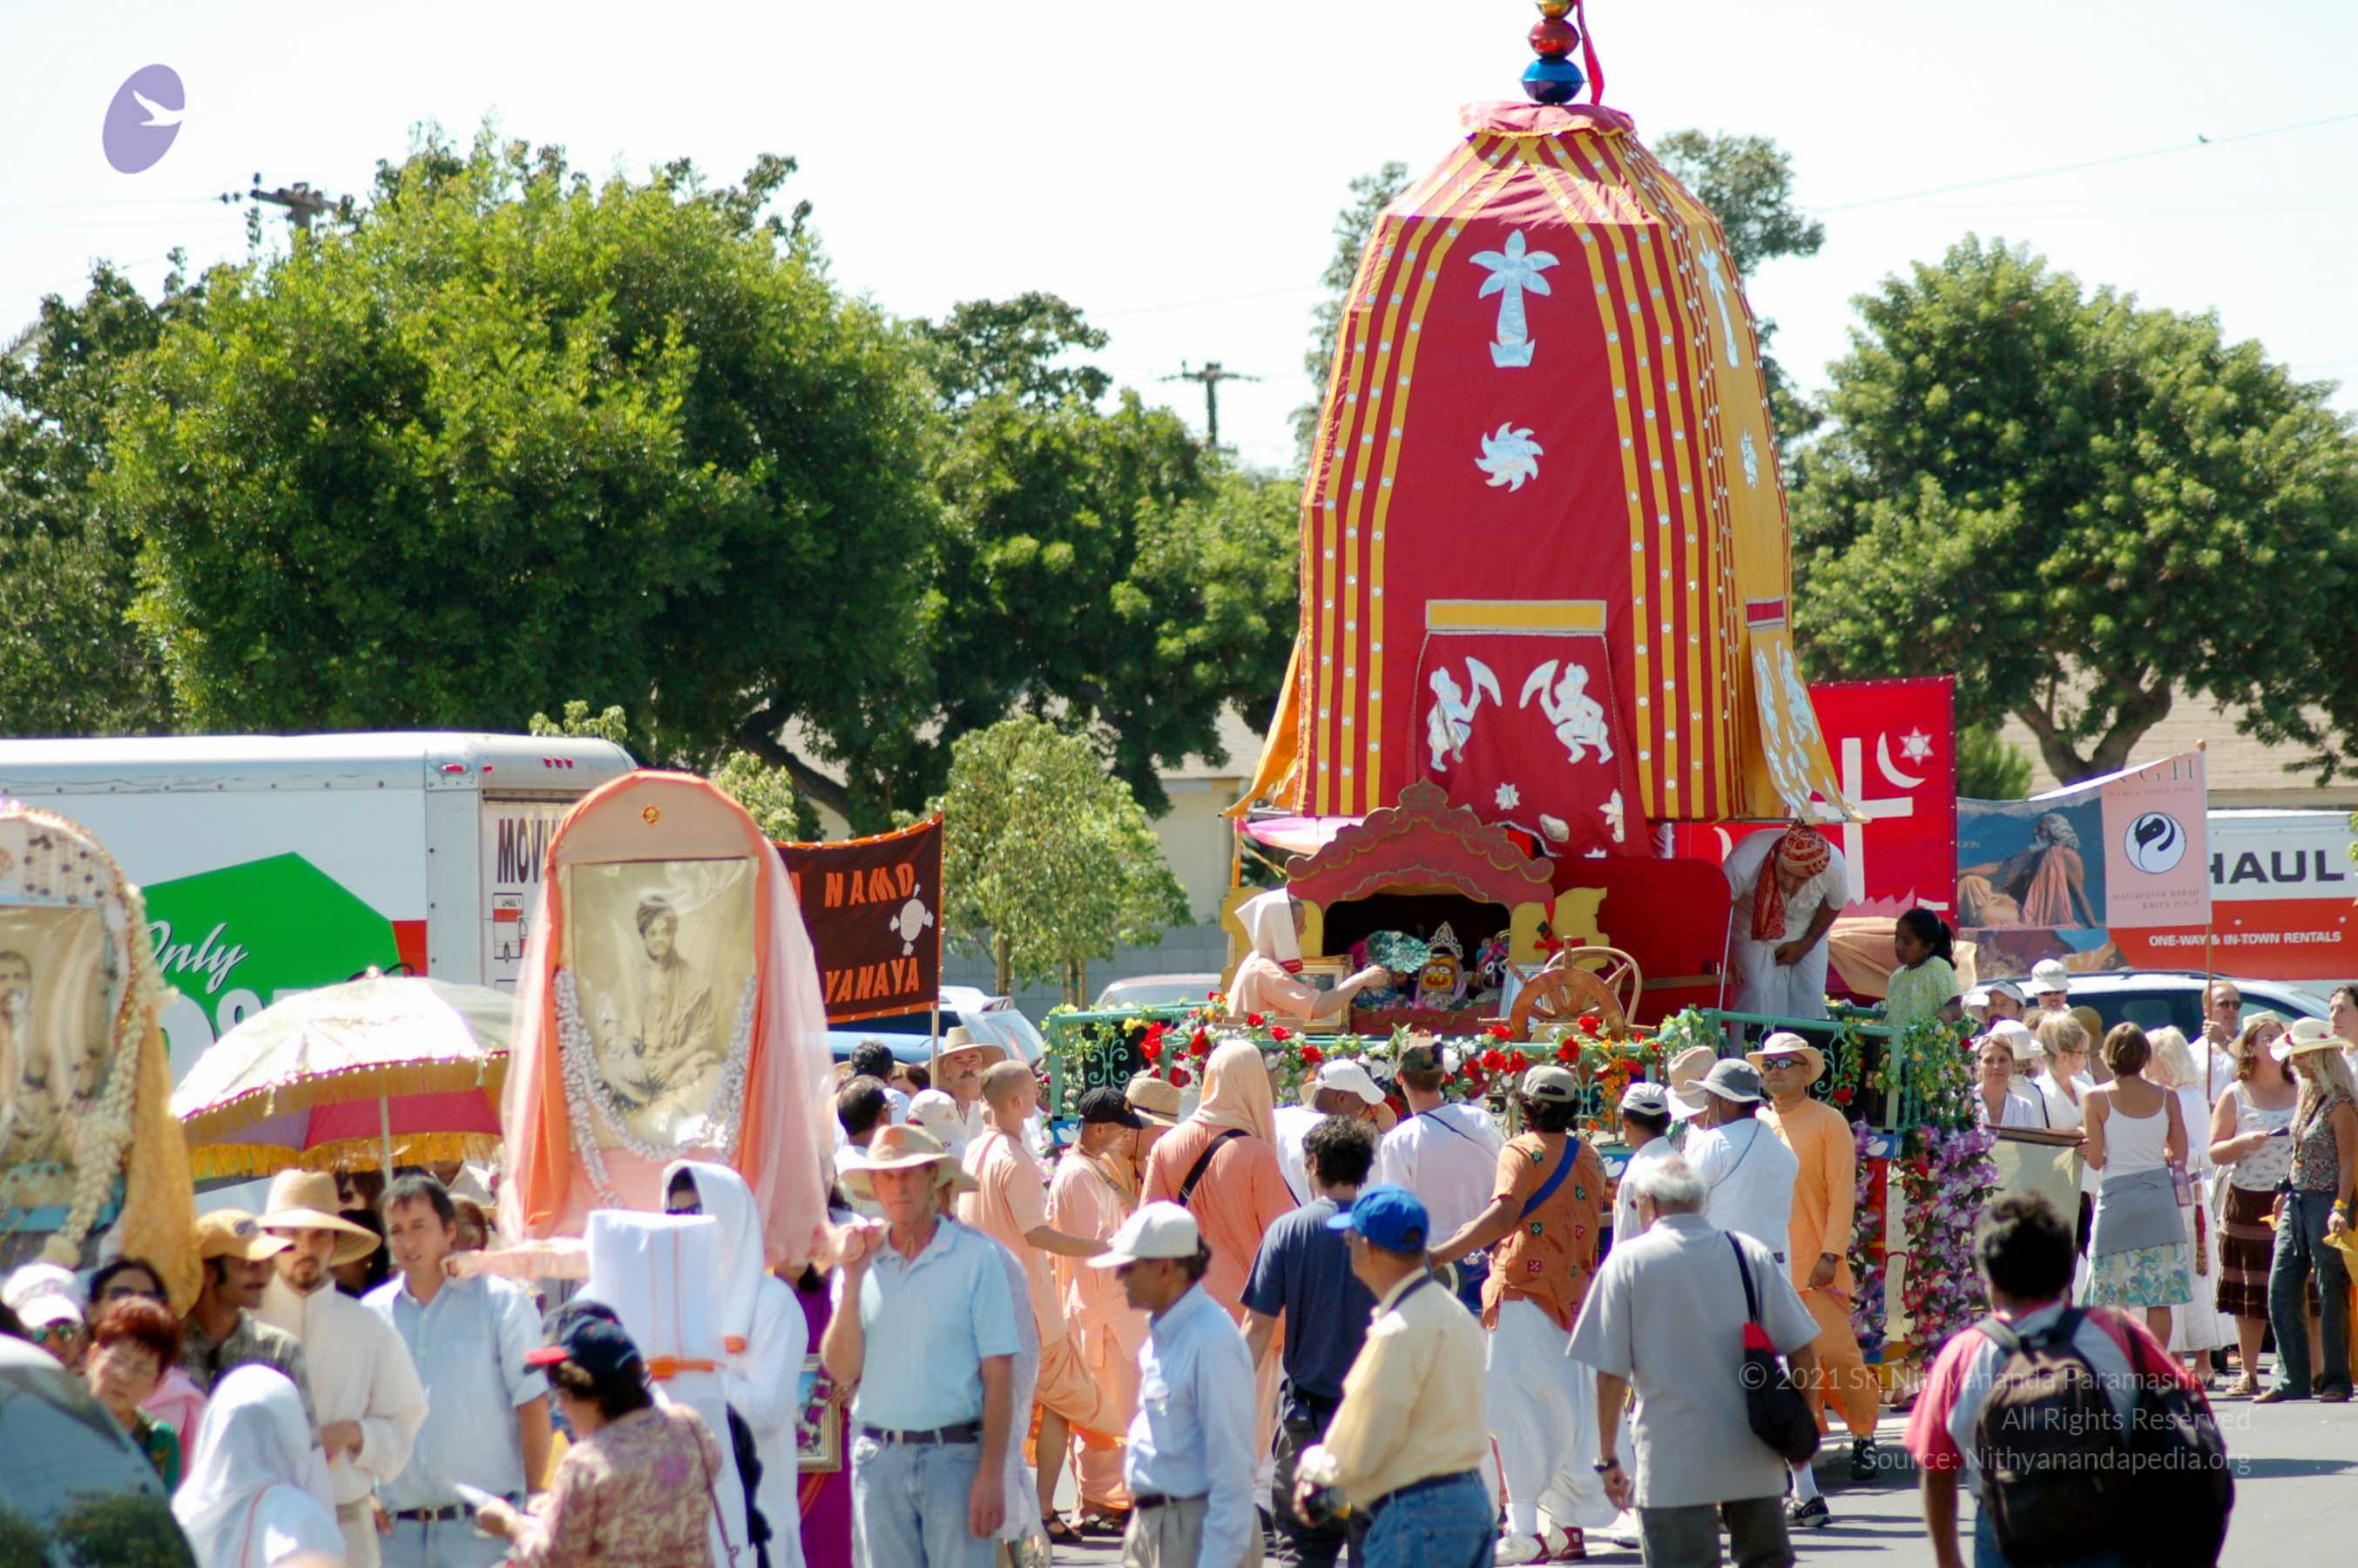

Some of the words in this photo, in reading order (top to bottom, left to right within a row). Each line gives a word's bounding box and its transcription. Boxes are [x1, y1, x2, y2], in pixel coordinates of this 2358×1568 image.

[825, 862, 915, 908] NAMO
[2149, 935, 2206, 947] ONE-WAY
[2211, 935, 2220, 945] &
[2224, 933, 2280, 945] IN-TOWN
[2284, 931, 2342, 943] RENTALS
